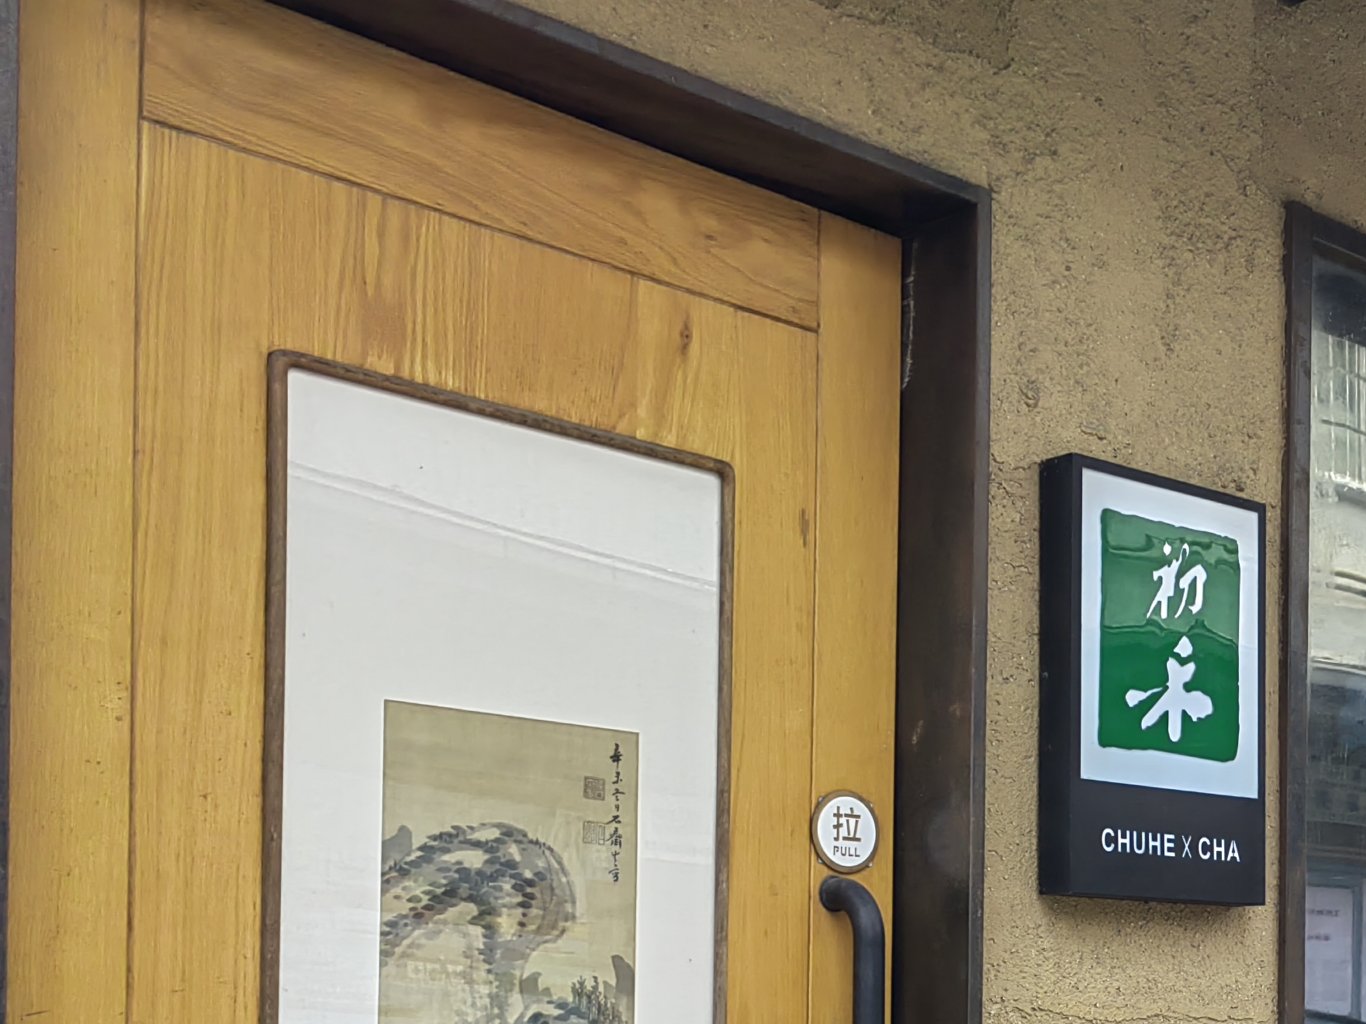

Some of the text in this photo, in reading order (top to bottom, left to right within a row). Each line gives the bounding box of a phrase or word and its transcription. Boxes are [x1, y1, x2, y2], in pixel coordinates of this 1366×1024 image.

[1125, 543, 1213, 742] 初禾
[832, 805, 862, 842] 拉
[832, 845, 861, 858] PULL
[1101, 827, 1176, 858] CHUHE
[1198, 836, 1241, 863] CHA
